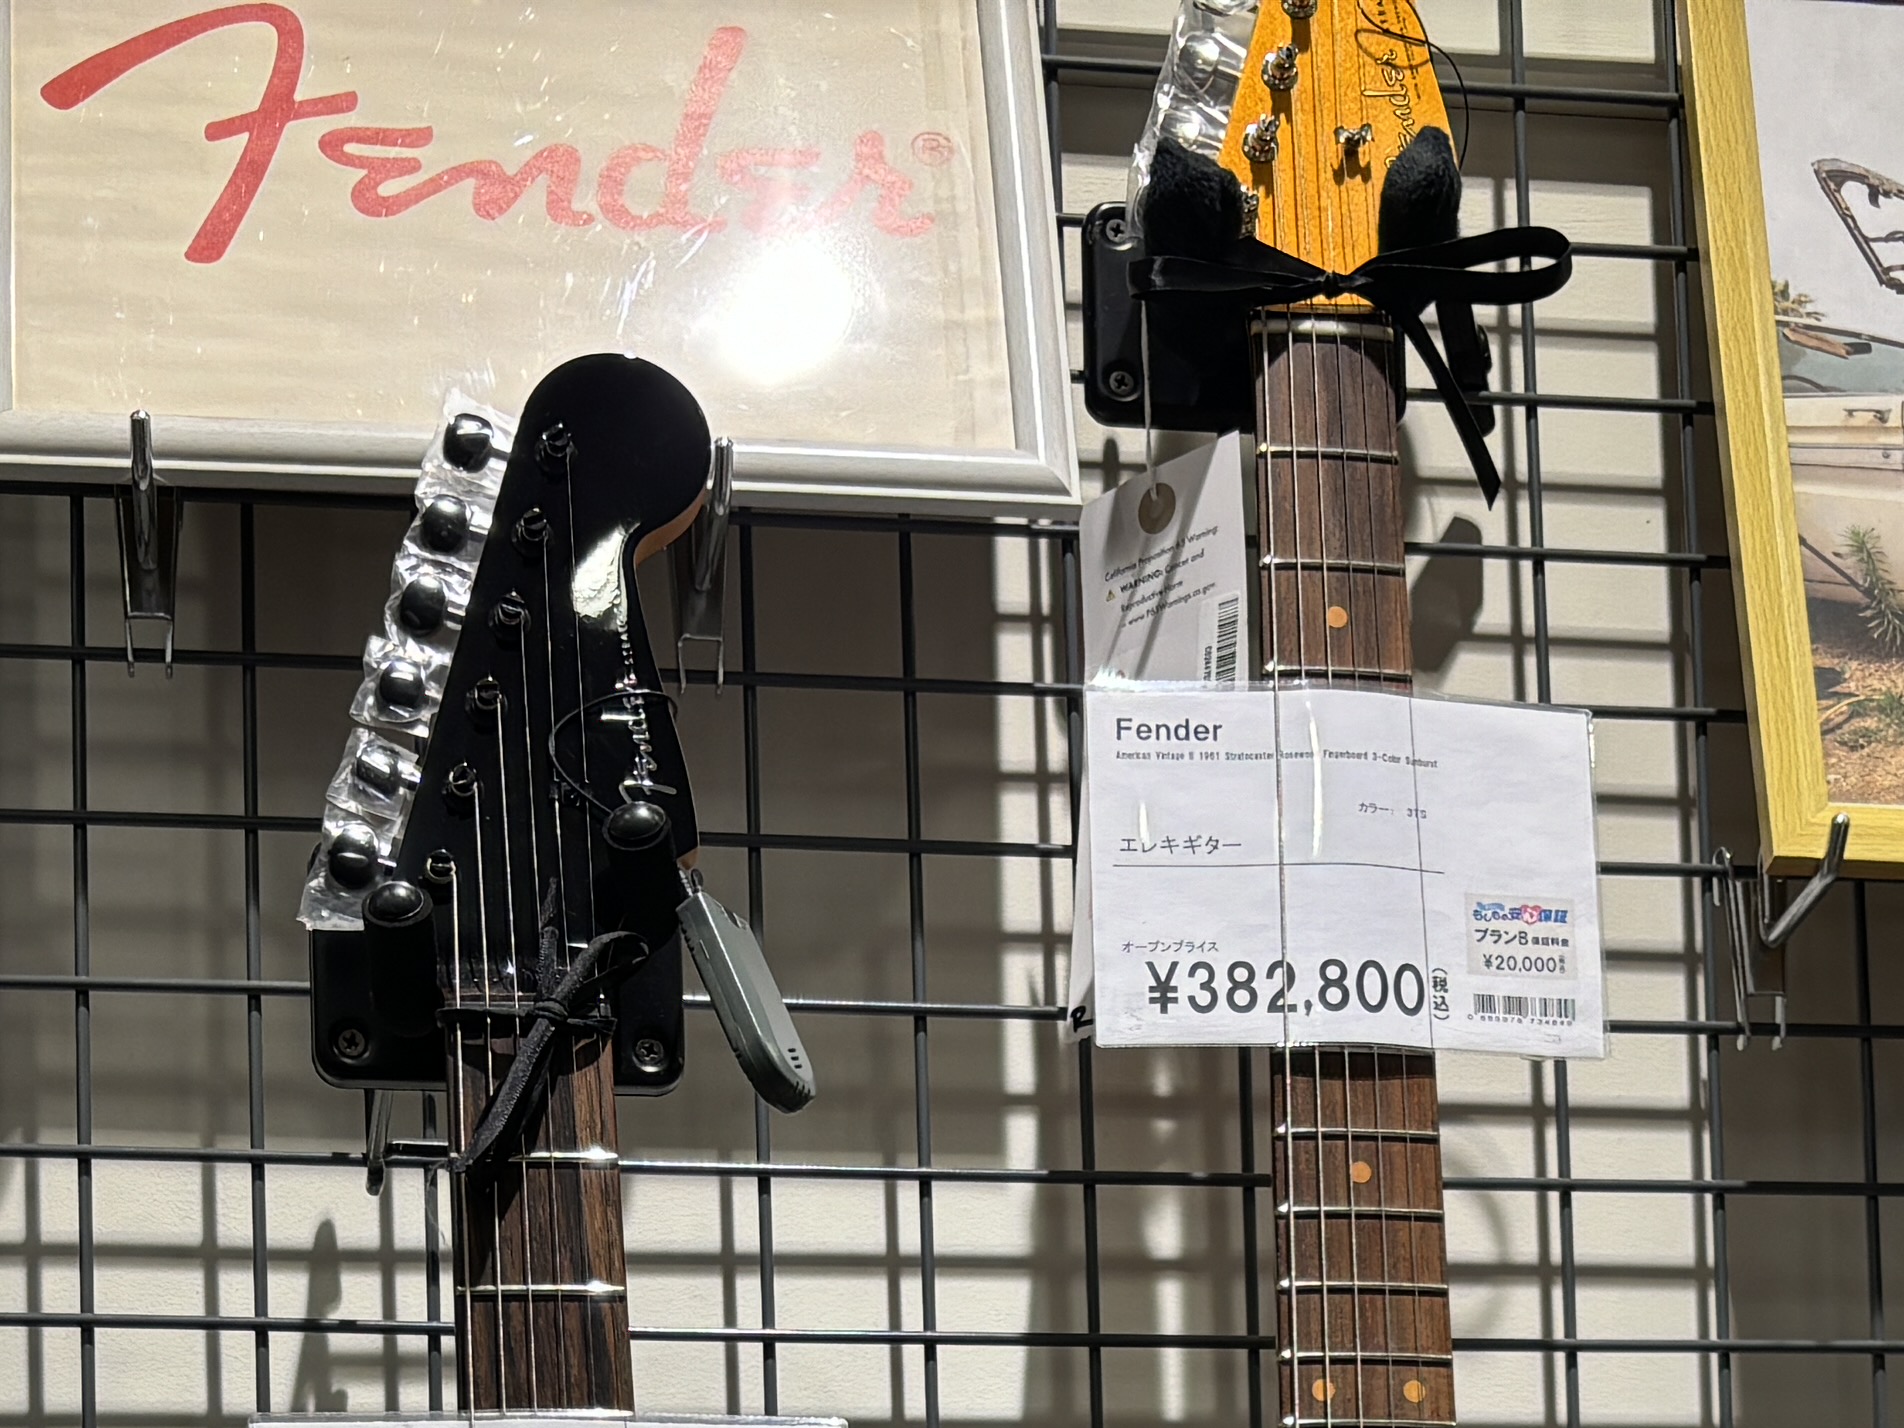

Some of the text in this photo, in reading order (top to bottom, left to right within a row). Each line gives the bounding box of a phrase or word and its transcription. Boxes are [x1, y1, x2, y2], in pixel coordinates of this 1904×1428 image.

[1116, 718, 1222, 743] Fender
[1120, 835, 1242, 855] エレキギター
[1483, 954, 1557, 973] ¥20,000
[1146, 960, 1425, 1017] ¥382,800
